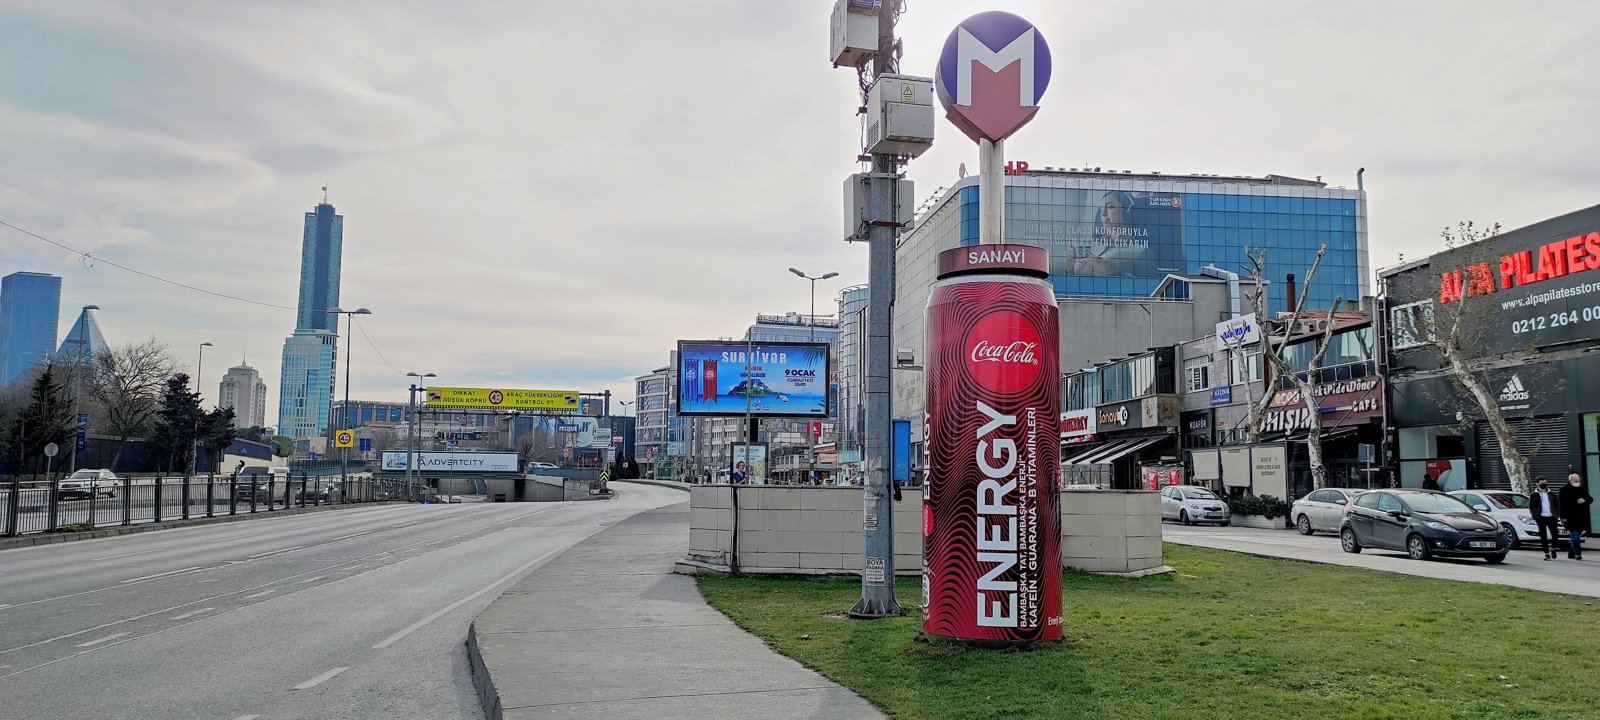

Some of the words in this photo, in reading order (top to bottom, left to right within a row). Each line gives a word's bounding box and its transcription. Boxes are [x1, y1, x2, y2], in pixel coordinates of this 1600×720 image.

[957, 26, 1035, 106] M
[1066, 224, 1092, 235] CLASS
[1095, 226, 1148, 237] KONFORUYLA
[969, 249, 1025, 264] SANAYİ
[1500, 231, 1600, 289] PILATES
[1512, 316, 1546, 334] 0212
[1550, 309, 1579, 328] 264
[971, 340, 1037, 362] Coca-Cola
[1349, 378, 1376, 392] Döner
[1500, 390, 1529, 401] adidas
[923, 411, 931, 500] ENERGY
[1026, 407, 1037, 487] VİTAMİNLERİ
[976, 400, 1018, 628] ENERGY
[1029, 489, 1037, 498] B
[1020, 496, 1029, 549] BAMBAŞKA
[1029, 508, 1037, 571] GUARANA
[1020, 550, 1028, 571] TAT,
[1020, 573, 1029, 627] BAMBAŞKA
[1027, 580, 1038, 627] KAFEİN
